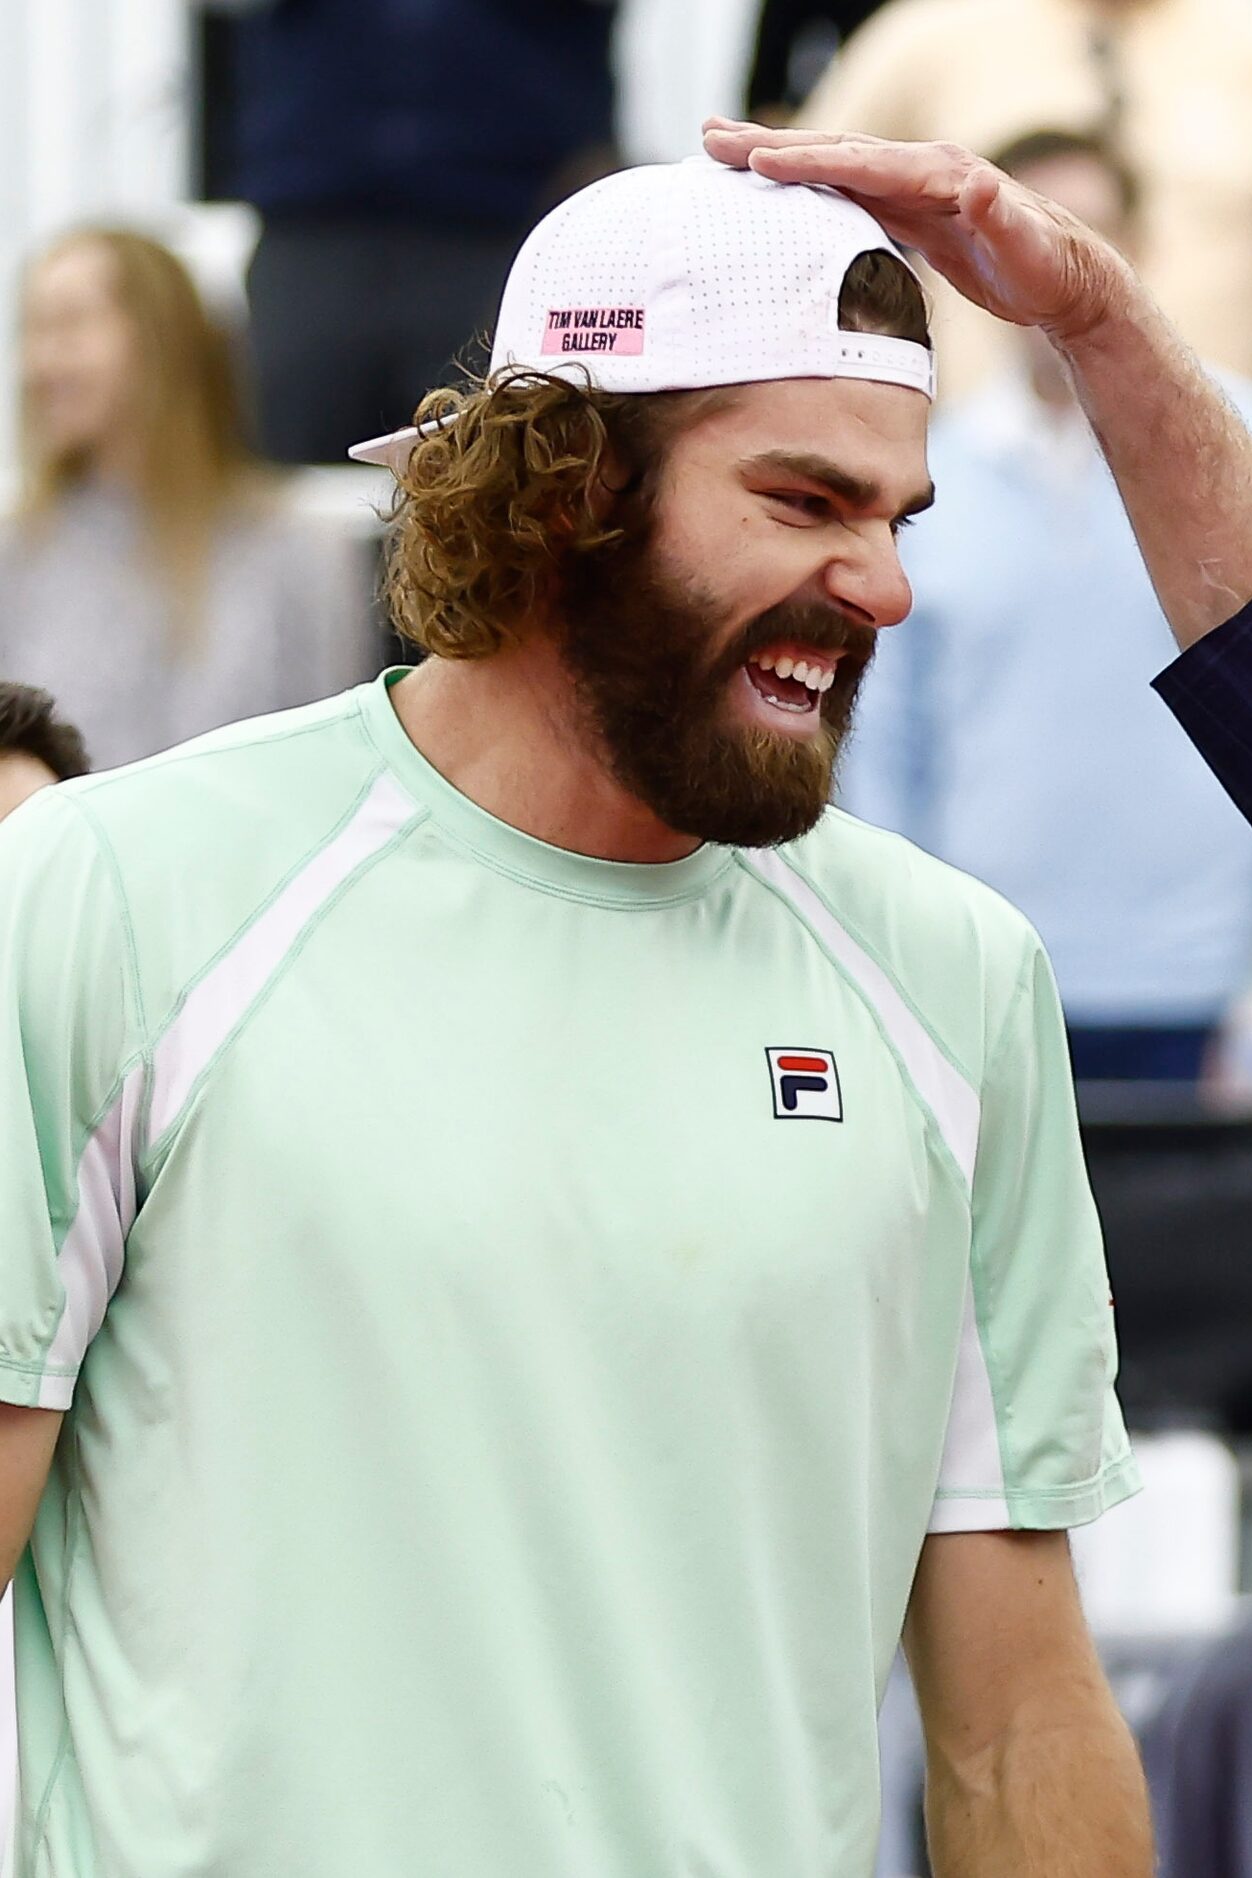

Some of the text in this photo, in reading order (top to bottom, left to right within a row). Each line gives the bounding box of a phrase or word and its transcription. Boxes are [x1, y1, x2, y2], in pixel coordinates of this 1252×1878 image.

[549, 309, 644, 329] TIM VAN LAERE
[561, 332, 617, 351] GALLERY
